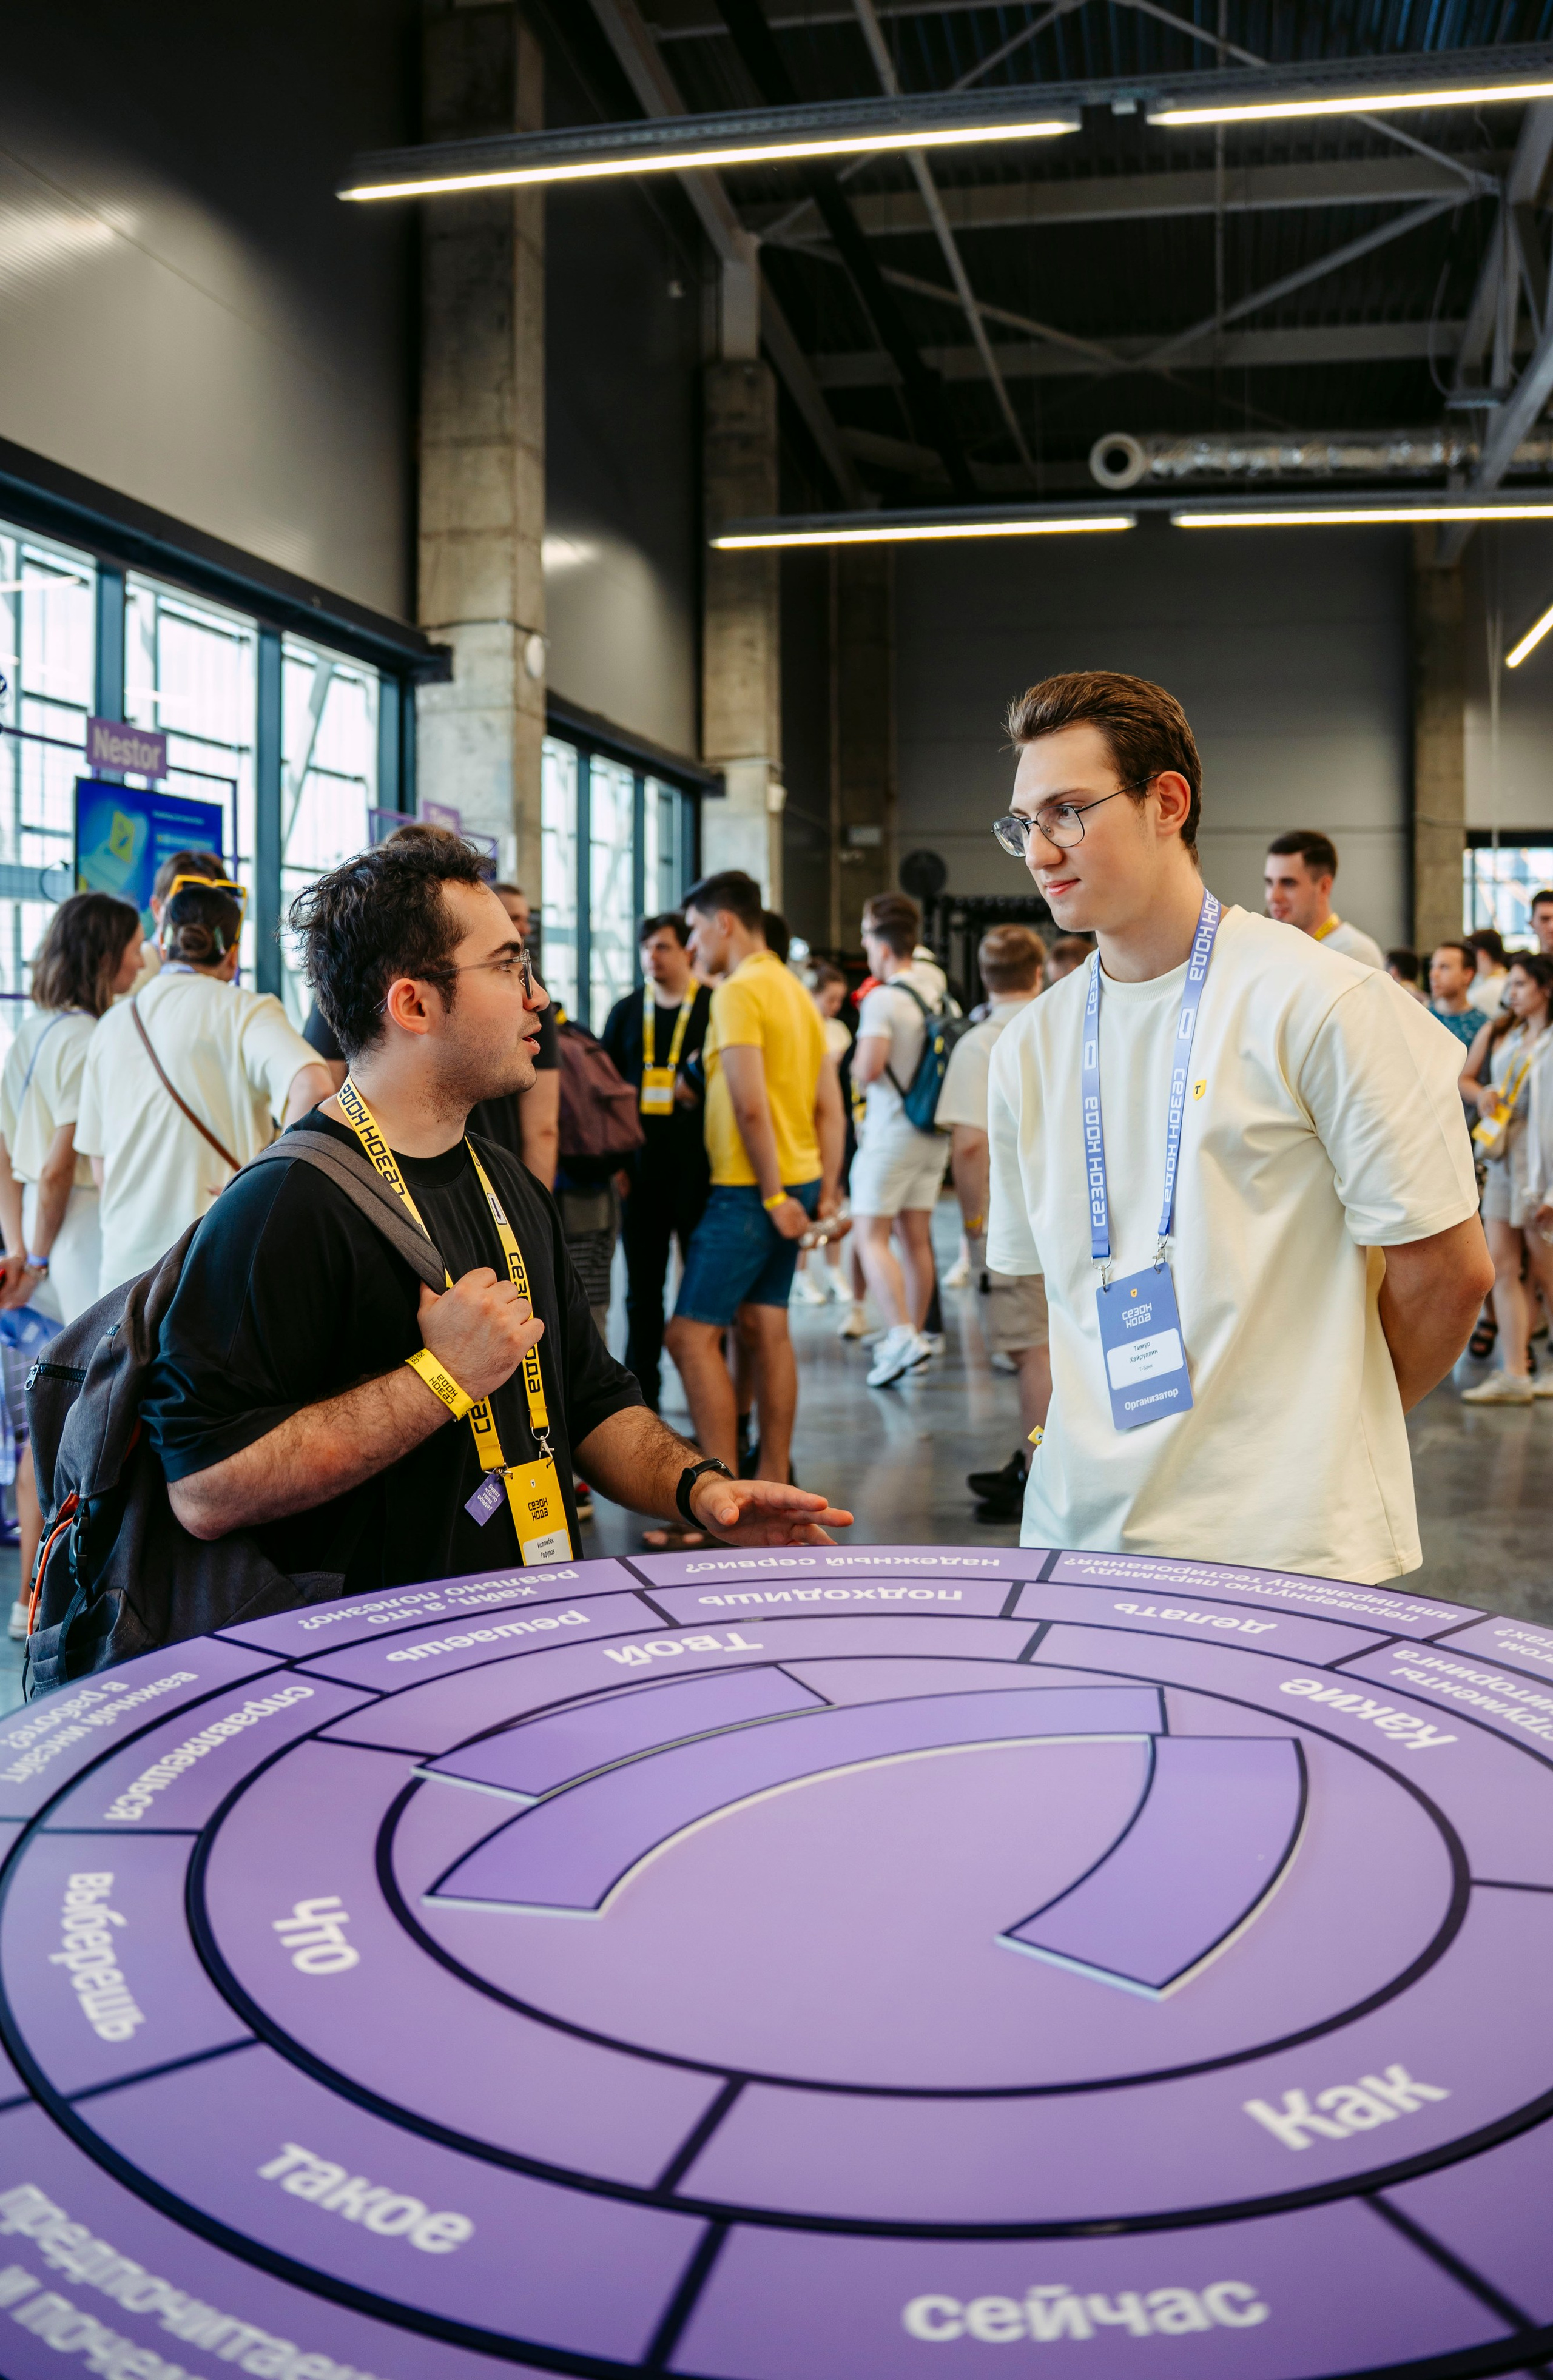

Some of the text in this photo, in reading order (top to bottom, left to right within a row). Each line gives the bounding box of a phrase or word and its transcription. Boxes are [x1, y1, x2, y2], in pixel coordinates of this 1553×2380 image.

[93, 725, 161, 771] Nestor
[1189, 889, 1219, 981] зон кода
[339, 1083, 369, 1126] кода
[1085, 1095, 1106, 1227] сезон кода
[1164, 1068, 1185, 1203] сезон кода
[508, 1252, 541, 1394] сез ода
[1122, 1302, 1153, 1320] сезон
[1125, 1313, 1151, 1328] кода
[1130, 1349, 1159, 1363] Хайруллин
[1134, 1342, 1151, 1351] Тимур
[429, 1376, 454, 1404] сезон
[437, 1374, 458, 1397] кода
[1124, 1388, 1179, 1411] Организатор
[528, 1497, 548, 1511] сезон
[531, 1508, 548, 1521] кода
[541, 1549, 555, 1559] Гафуров
[686, 1557, 1000, 1573] надежный сервис?
[298, 1569, 579, 1630] реально полезно?
[366, 1604, 424, 1624] что
[425, 1602, 446, 1612] а
[698, 1587, 963, 1606] подходишь
[1064, 1558, 1458, 1621] или пирамиду тестирования?
[1082, 1566, 1420, 1622] перевернутую пирамиду
[386, 1610, 590, 1662] решаешь
[1114, 1603, 1278, 1634] делать
[101, 1681, 130, 1692] в
[1389, 1667, 1553, 1742] струменты
[1392, 1650, 1553, 1715] иторинга
[0, 1672, 200, 1784] важный инсайт
[1279, 1678, 1458, 1750] Какие
[104, 1686, 315, 1821] справляешься
[48, 1871, 146, 2043] выберешь
[272, 1895, 360, 1975] Что
[1242, 2063, 1453, 2151] Как
[257, 2142, 476, 2254] такое
[0, 2183, 388, 2380] предпочитае
[902, 2281, 1272, 2344] сейчас
